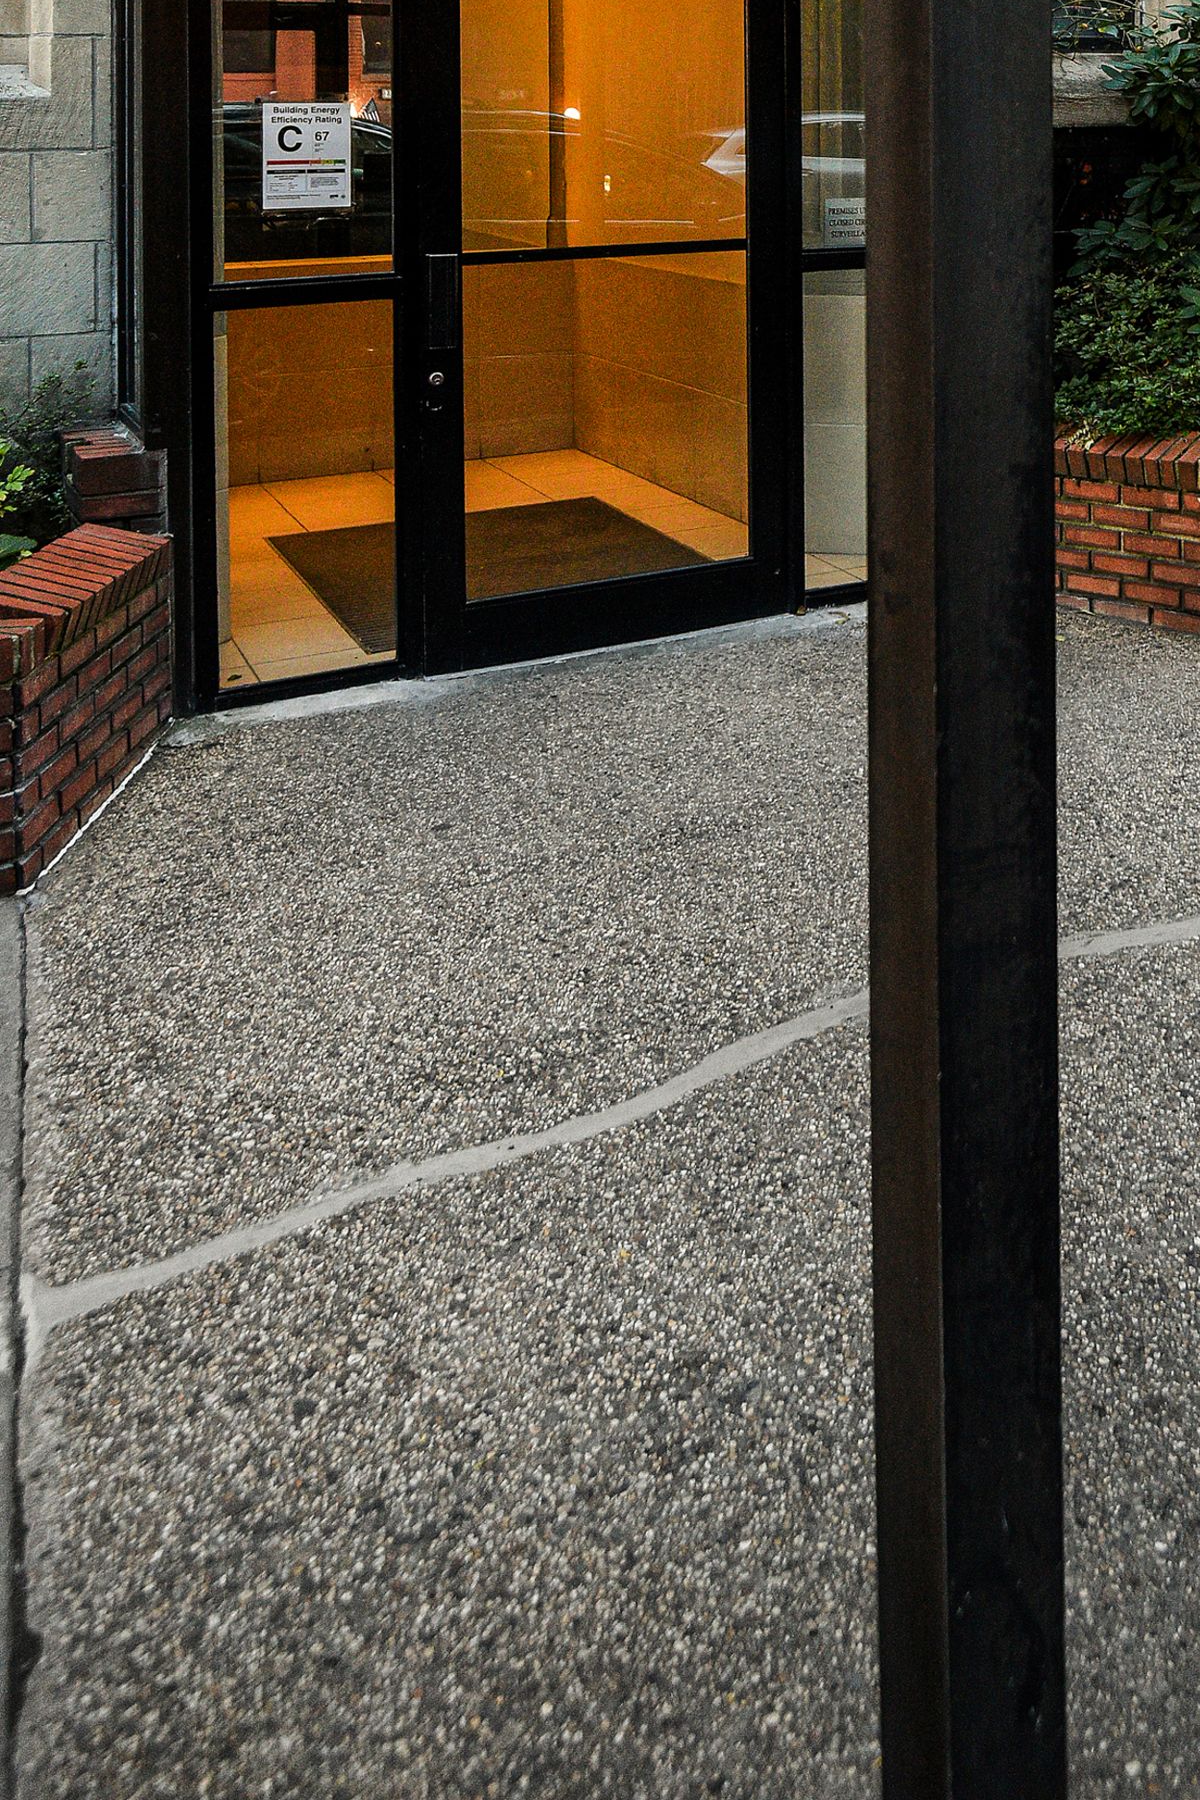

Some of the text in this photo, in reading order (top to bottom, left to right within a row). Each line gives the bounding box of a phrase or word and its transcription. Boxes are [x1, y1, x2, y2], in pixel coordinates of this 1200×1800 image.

[273, 106, 341, 115] Building Energy
[271, 116, 342, 125] Efficiency Rating
[277, 125, 303, 152] C
[314, 131, 330, 141] 67
[830, 230, 867, 238] SURVEILLA
